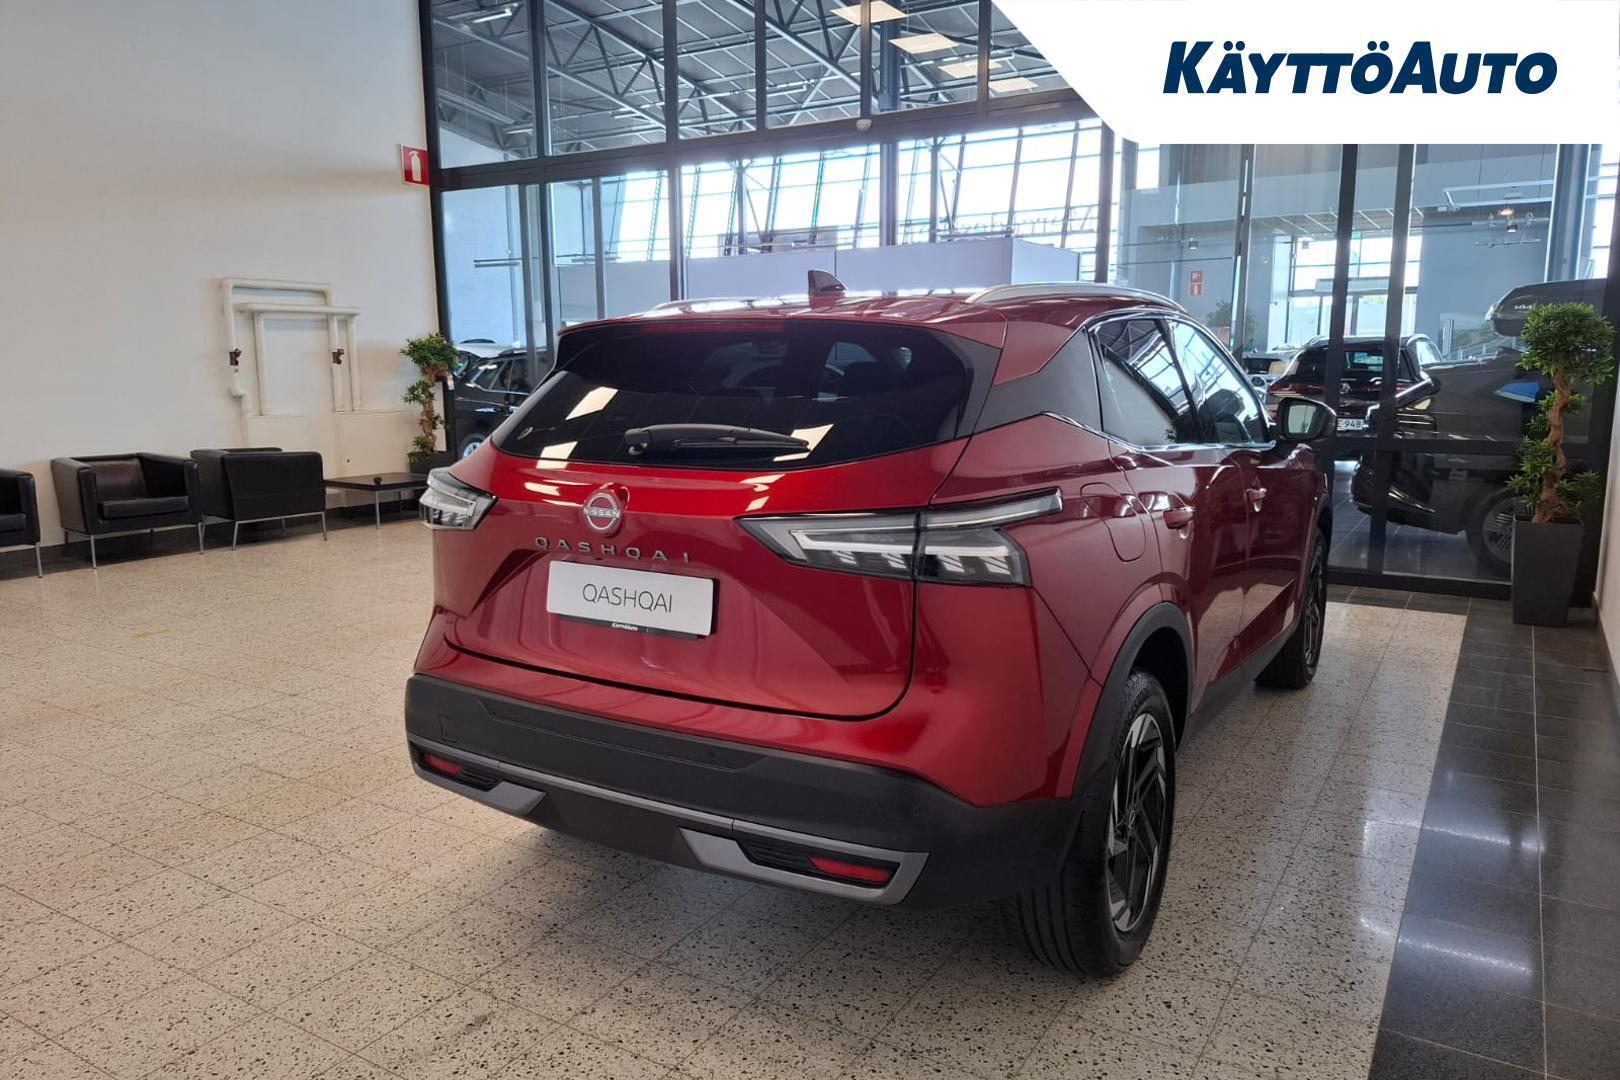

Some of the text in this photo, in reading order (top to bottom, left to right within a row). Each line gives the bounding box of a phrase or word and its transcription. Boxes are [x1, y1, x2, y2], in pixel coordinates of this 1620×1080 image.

[583, 506, 620, 518] NISSAN
[535, 537, 690, 561] QASHQAI
[582, 583, 673, 613] QASHQAI
